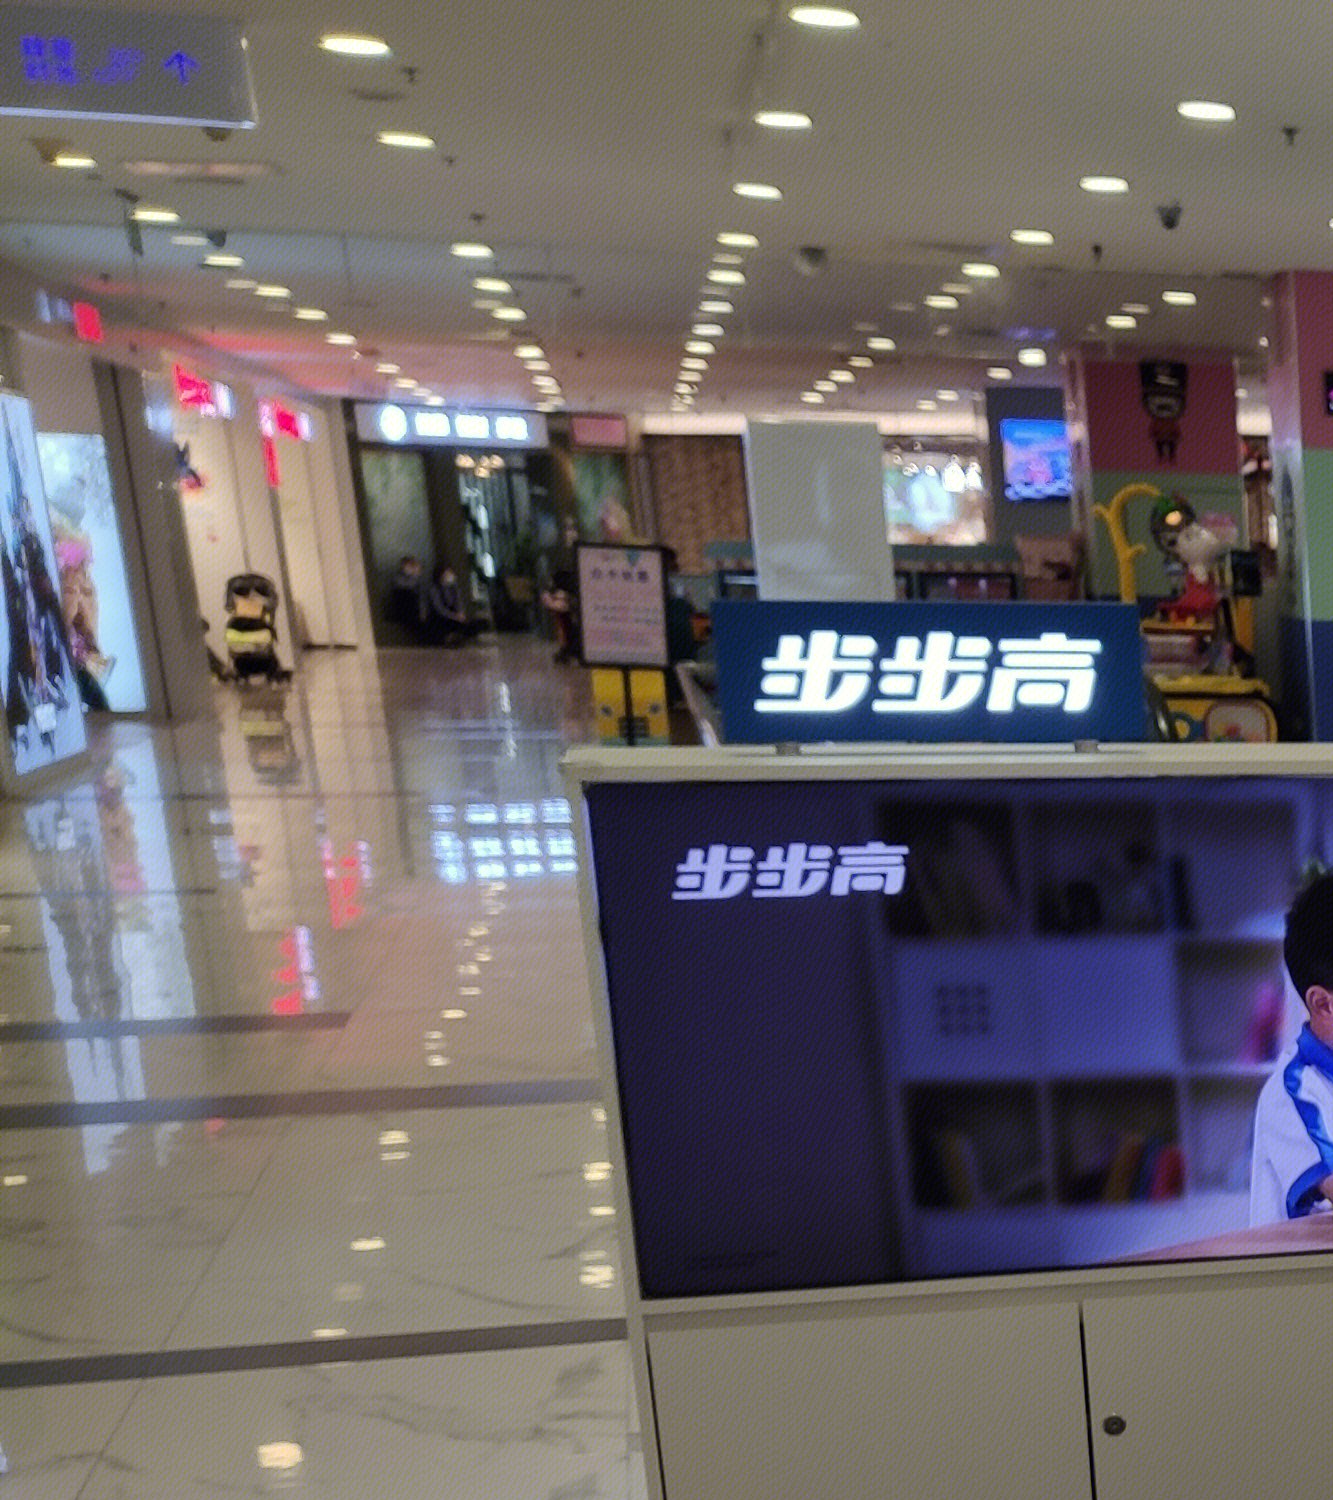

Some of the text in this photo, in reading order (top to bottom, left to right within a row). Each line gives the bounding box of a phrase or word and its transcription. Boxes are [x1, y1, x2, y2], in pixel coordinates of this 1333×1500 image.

[754, 629, 1102, 714] 步步高
[672, 841, 909, 901] 步步高
